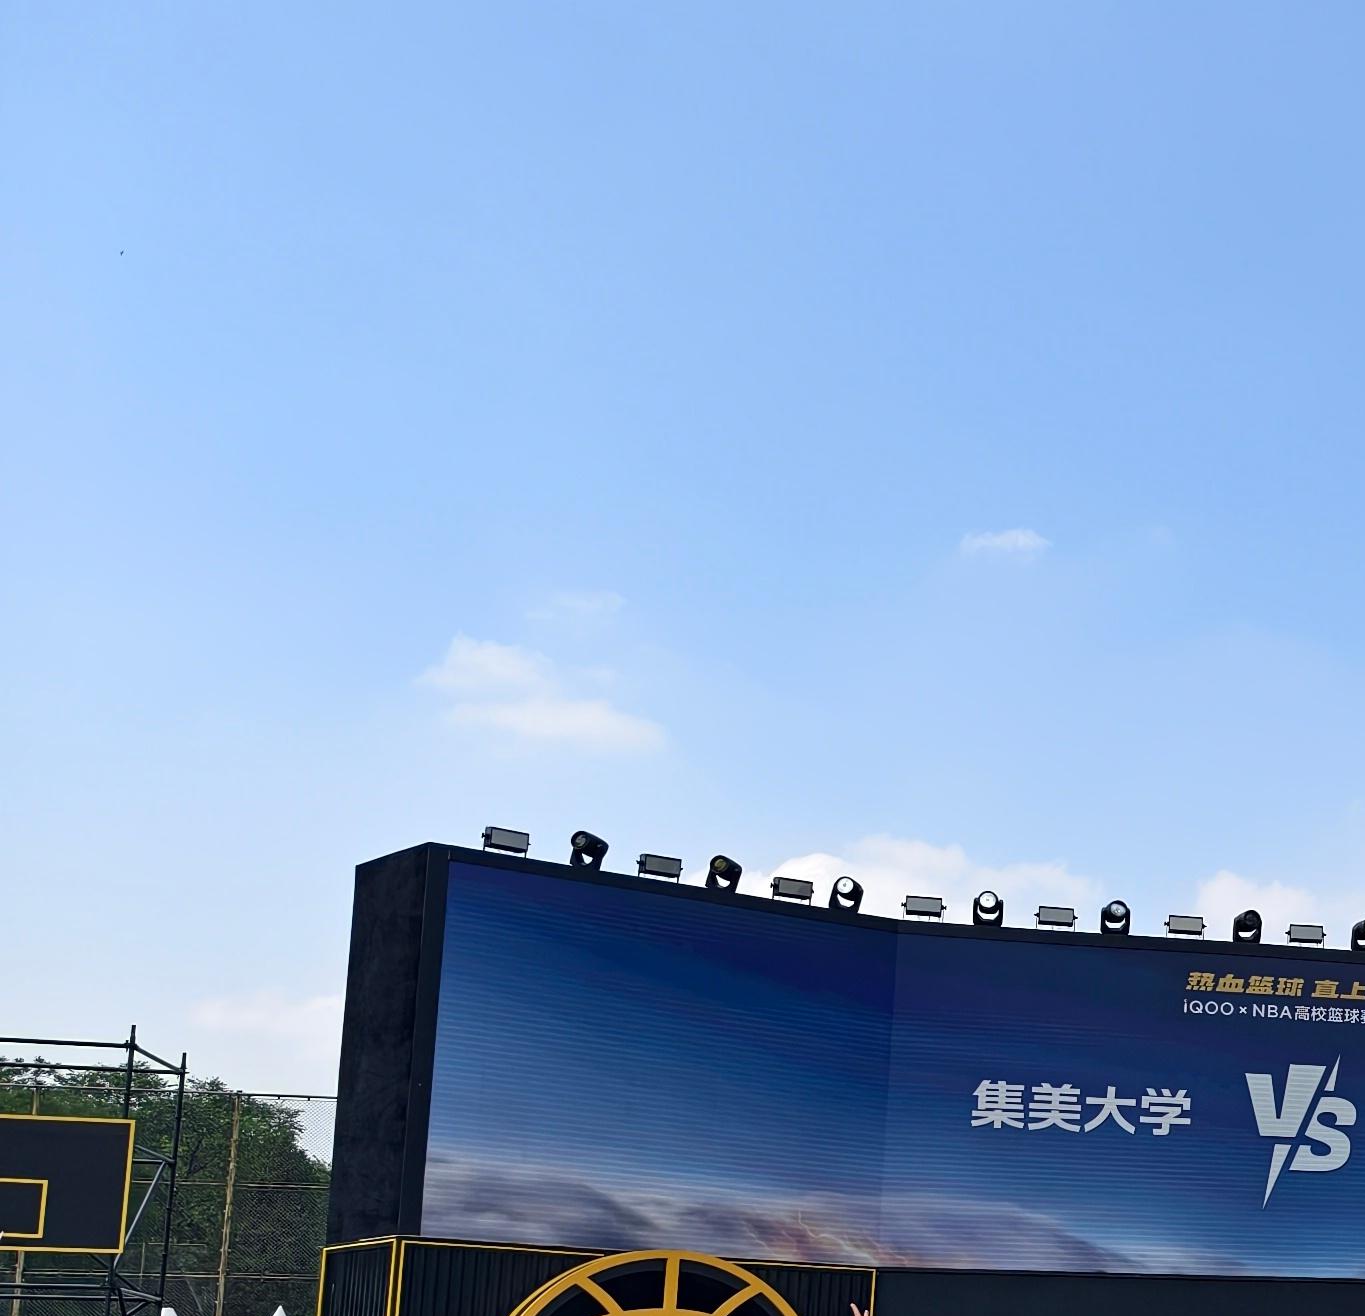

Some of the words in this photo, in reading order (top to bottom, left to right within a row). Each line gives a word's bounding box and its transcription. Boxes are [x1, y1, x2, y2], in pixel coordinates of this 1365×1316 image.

[1186, 971, 1305, 998] 热血篮球
[1183, 998, 1234, 1016] iQOO
[970, 1078, 1193, 1137] 集美大学
[1245, 1054, 1358, 1209] VS
